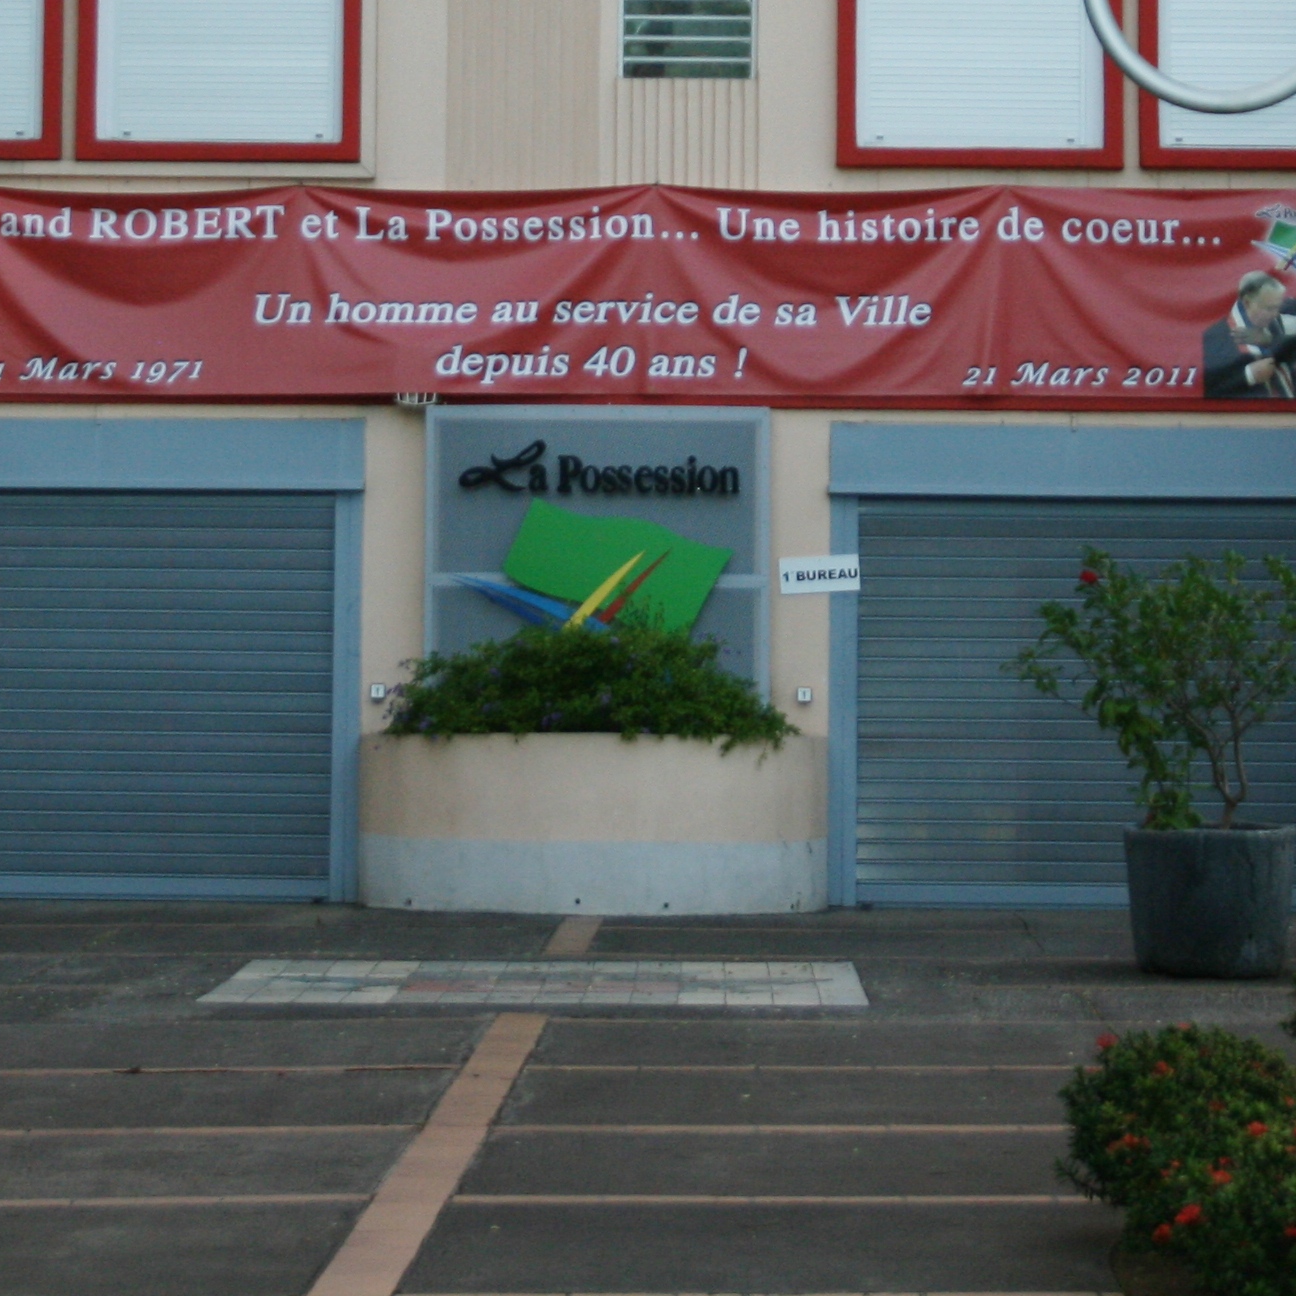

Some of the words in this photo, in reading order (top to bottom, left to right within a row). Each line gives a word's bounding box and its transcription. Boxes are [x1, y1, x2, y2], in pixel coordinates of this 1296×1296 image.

[88, 204, 285, 241] ROBERT
[300, 211, 339, 240] et
[354, 205, 408, 242] La
[425, 205, 699, 242] Possession...
[716, 207, 801, 242] Une
[817, 208, 980, 243] histoire
[997, 206, 1045, 242] de
[1061, 218, 1220, 245] coeur...
[254, 293, 312, 325] Un
[324, 292, 478, 325] homme
[490, 301, 539, 324] au
[553, 292, 699, 326] service
[712, 294, 761, 326] de
[774, 303, 818, 328] sa
[836, 295, 931, 327] Ville
[19, 357, 118, 381] Mars
[130, 361, 203, 384] 1971
[434, 344, 570, 385] depuis
[583, 346, 636, 377] 40
[648, 354, 716, 378] ans
[733, 347, 748, 379] !
[962, 367, 997, 387] 21
[1010, 362, 1109, 387] Mars
[1122, 367, 1197, 387] 2011
[458, 440, 548, 492] La
[556, 455, 739, 495] Possession
[796, 568, 858, 582] BUREAU
